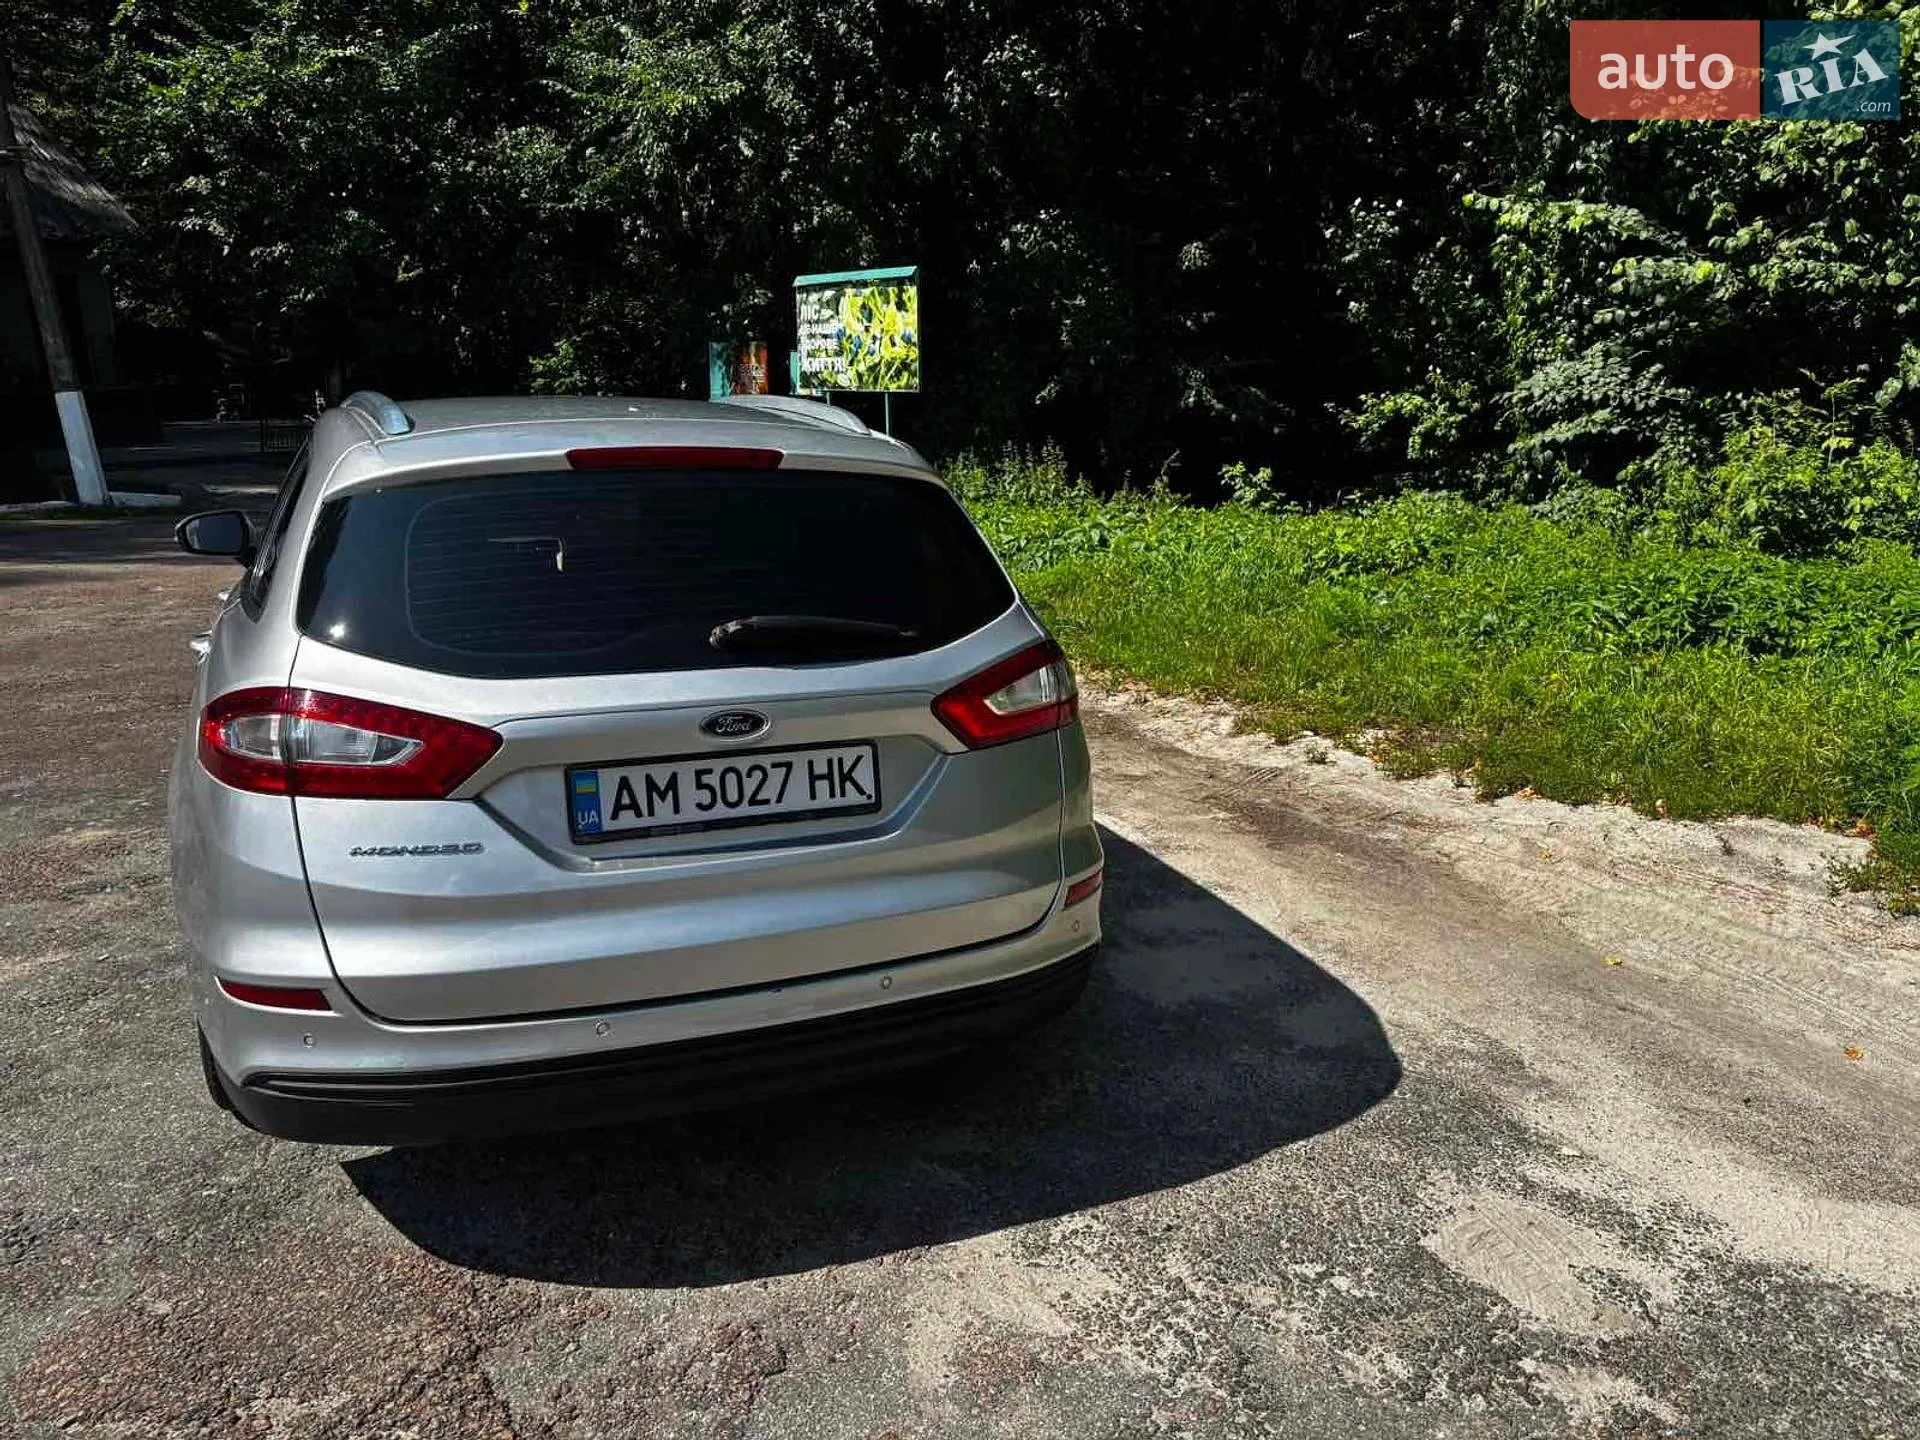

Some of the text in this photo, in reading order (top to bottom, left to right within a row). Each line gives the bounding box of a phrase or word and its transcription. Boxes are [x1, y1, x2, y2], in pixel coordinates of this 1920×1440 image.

[715, 716, 753, 733] Ford
[610, 754, 867, 821] AM 5027 HK
[578, 810, 599, 825] UA
[349, 842, 485, 857] MONDEO
